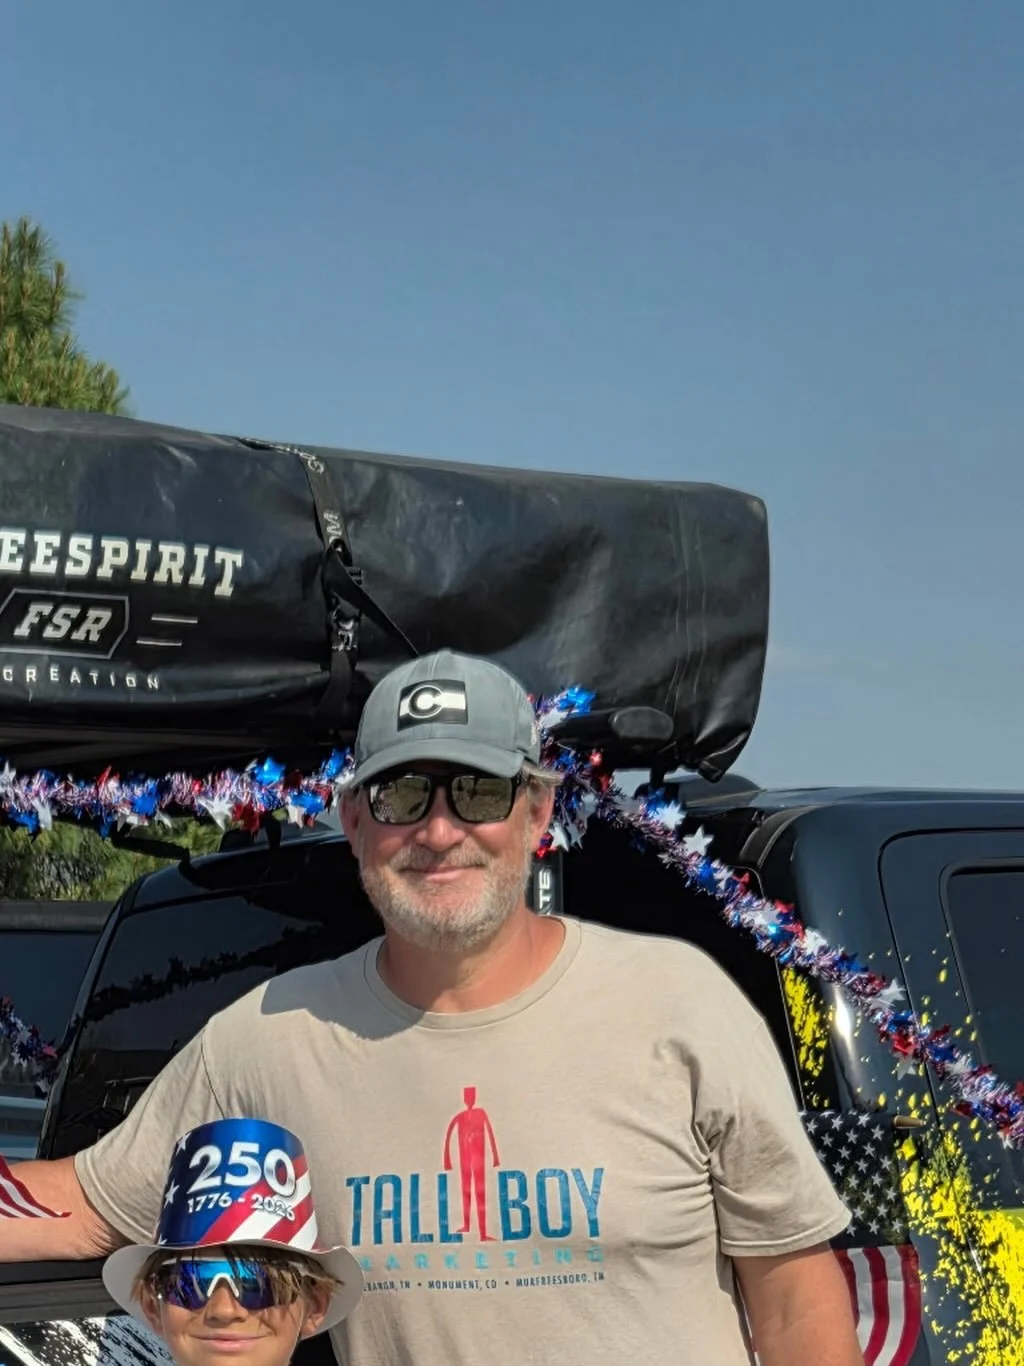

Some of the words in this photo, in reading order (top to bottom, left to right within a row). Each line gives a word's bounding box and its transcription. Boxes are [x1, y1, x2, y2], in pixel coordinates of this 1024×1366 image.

[13, 602, 112, 642] FSR
[186, 1141, 296, 1197] 250
[187, 1192, 233, 1214] 1776
[250, 1193, 296, 1221] 2026
[345, 1173, 464, 1247] TALL
[497, 1167, 605, 1242] BOY
